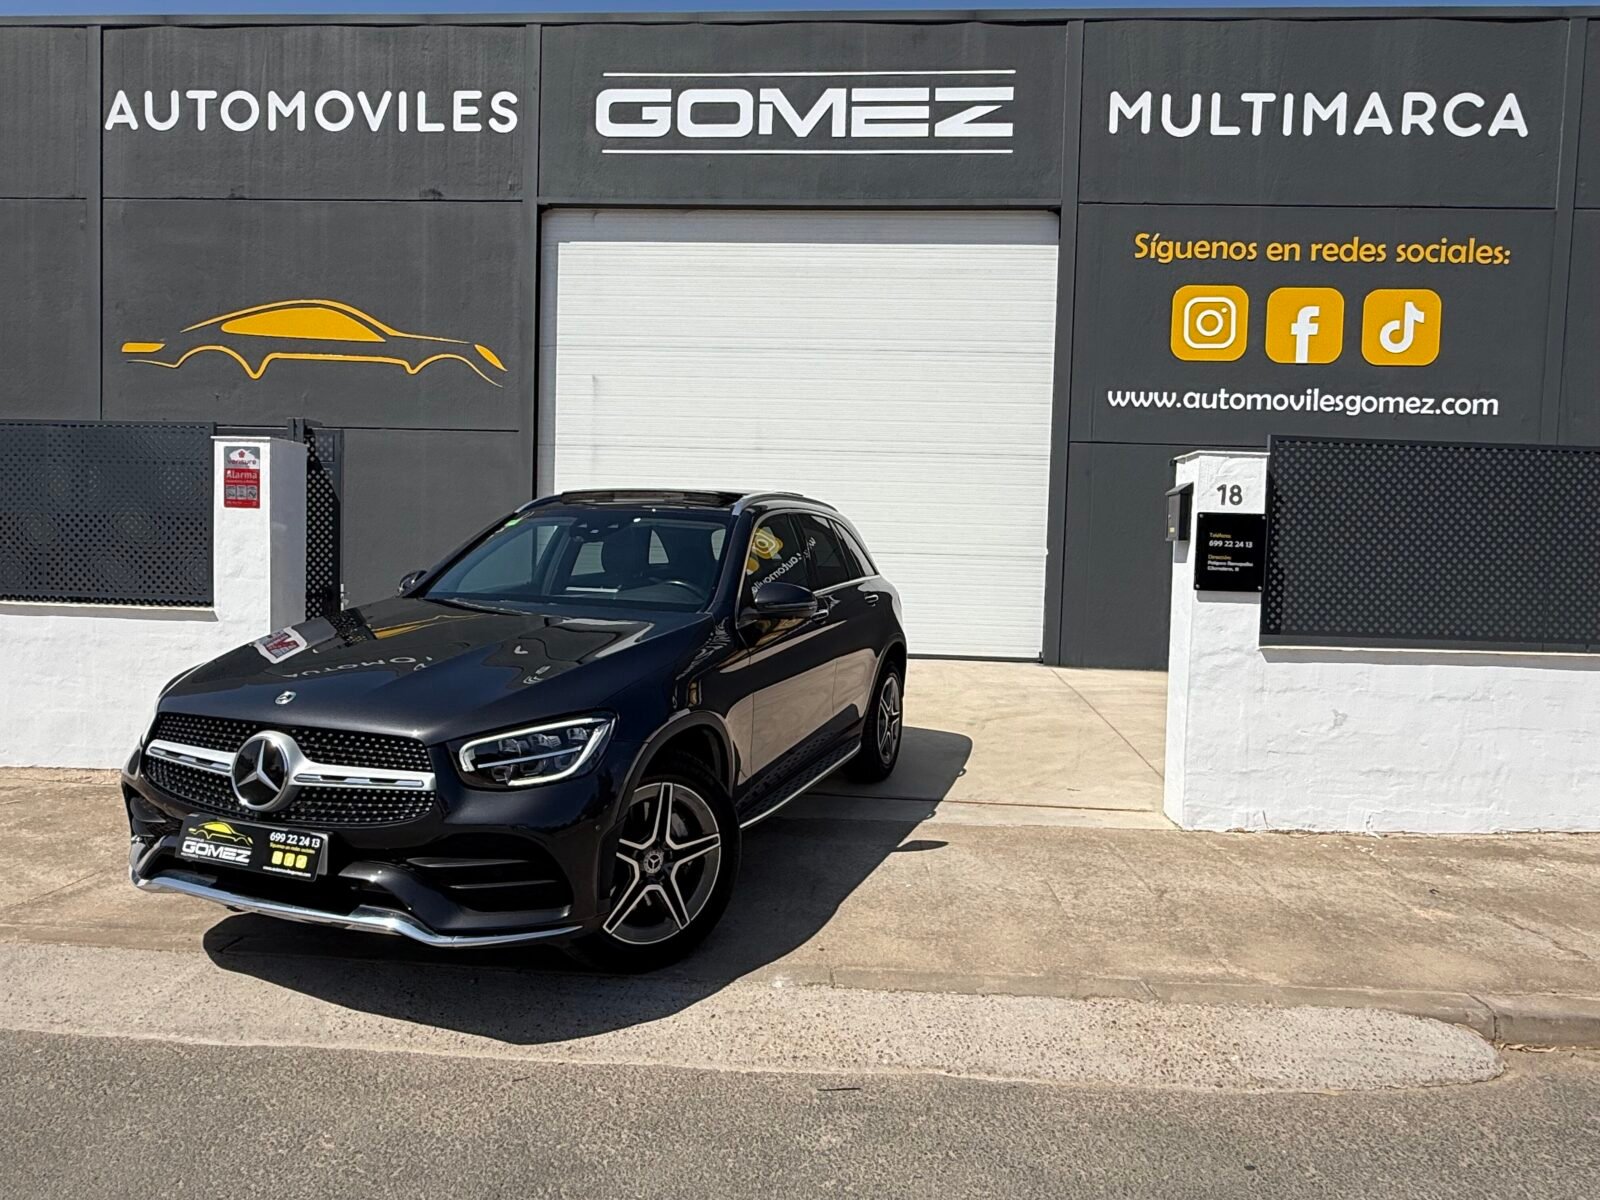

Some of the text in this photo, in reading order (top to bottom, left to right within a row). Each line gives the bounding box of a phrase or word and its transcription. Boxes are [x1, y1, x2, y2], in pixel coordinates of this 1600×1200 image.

[104, 89, 518, 133] AUTOMOVILES
[595, 86, 1015, 138] GOMEZ
[1108, 90, 1529, 138] MULTIMARCA
[1134, 232, 1511, 265] Síguenos en redes sociales:
[1107, 387, 1499, 416] www.automovilesgomez.com
[1216, 484, 1243, 506] 18
[181, 840, 252, 864] GOMEZ
[269, 831, 286, 843] 699
[287, 834, 298, 845] 22
[299, 836, 310, 846] 24
[311, 838, 321, 848] 13
